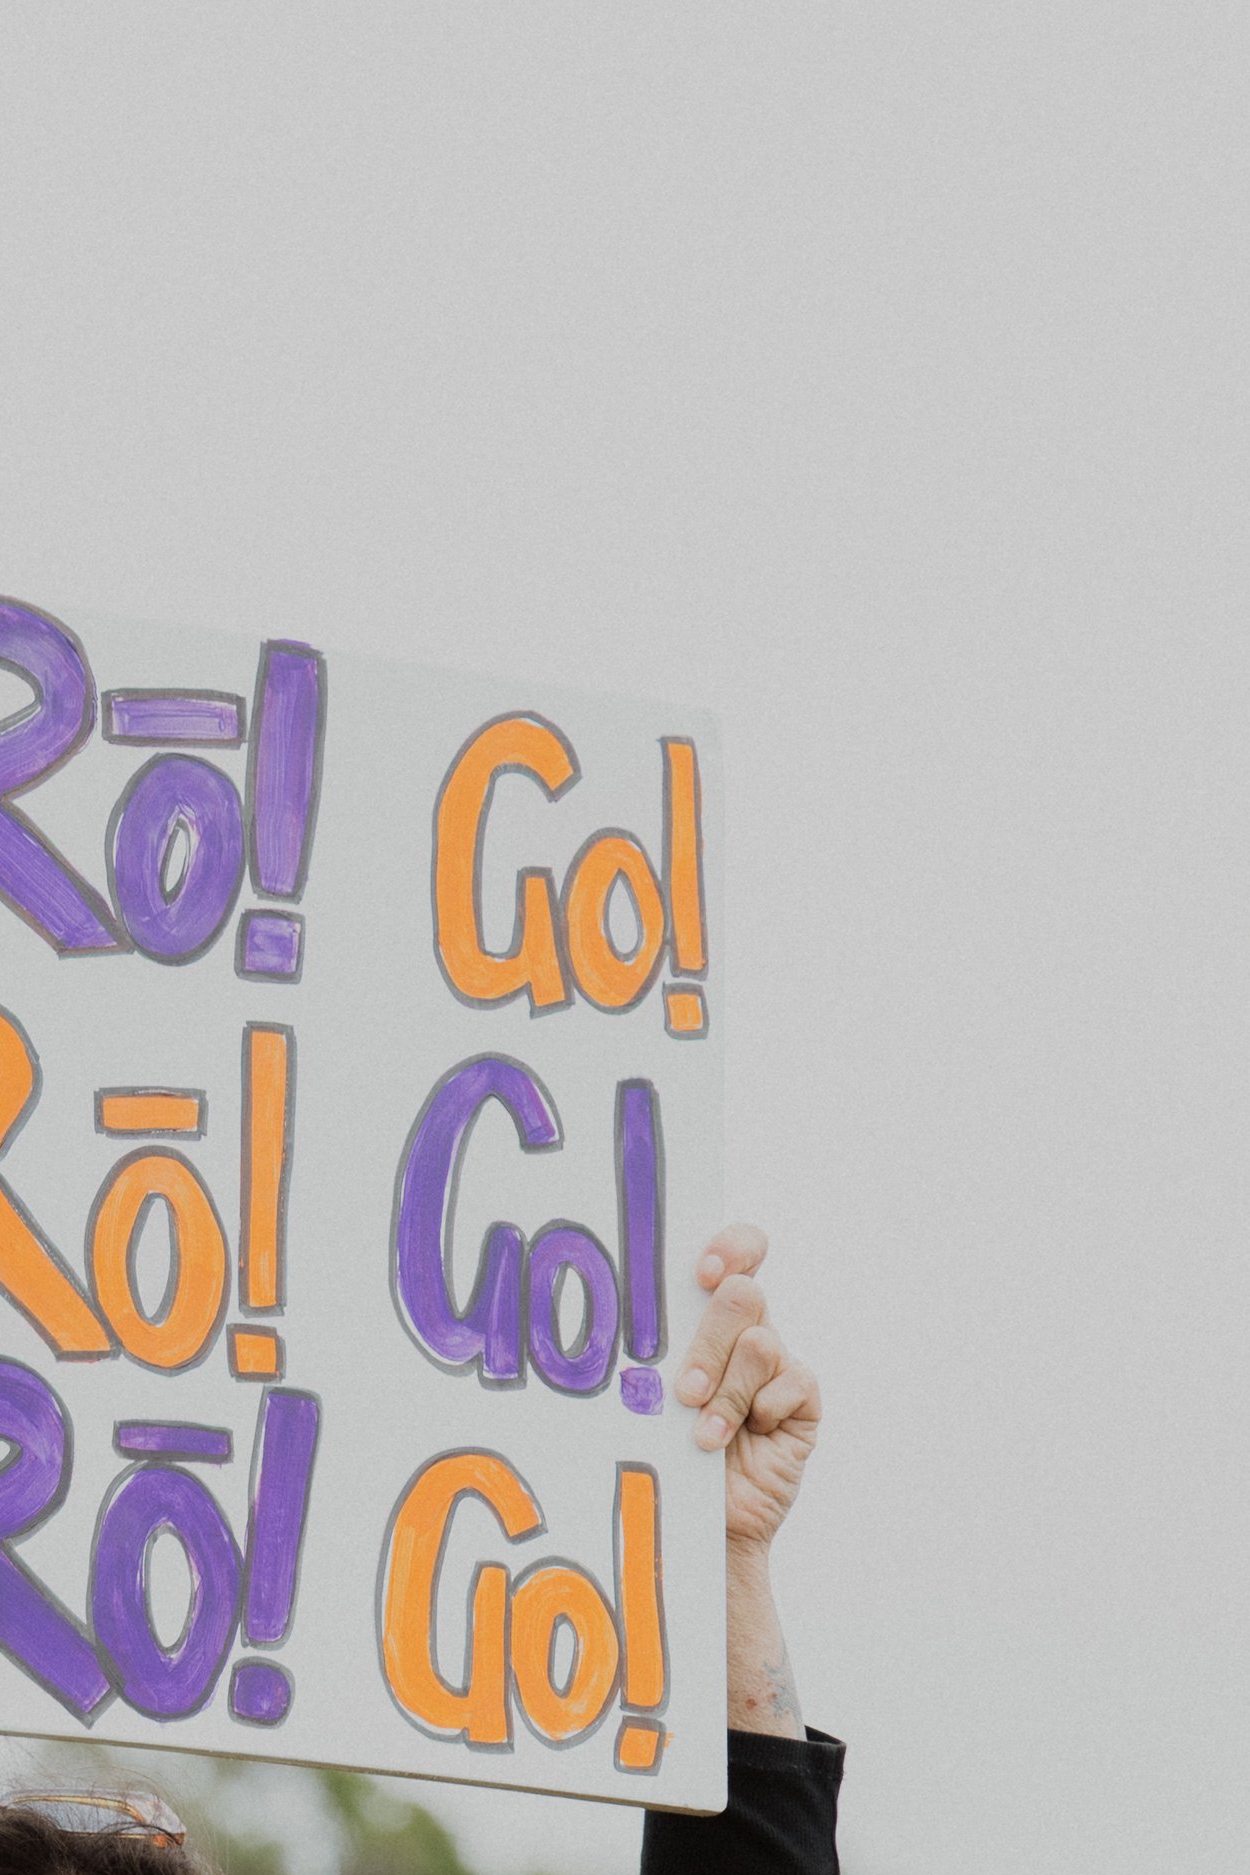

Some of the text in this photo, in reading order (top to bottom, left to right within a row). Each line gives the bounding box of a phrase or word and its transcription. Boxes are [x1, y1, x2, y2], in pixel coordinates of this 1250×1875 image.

[432, 710, 710, 1040] Go!
[389, 1051, 667, 1415] Go!
[375, 1446, 672, 1777] Go!
